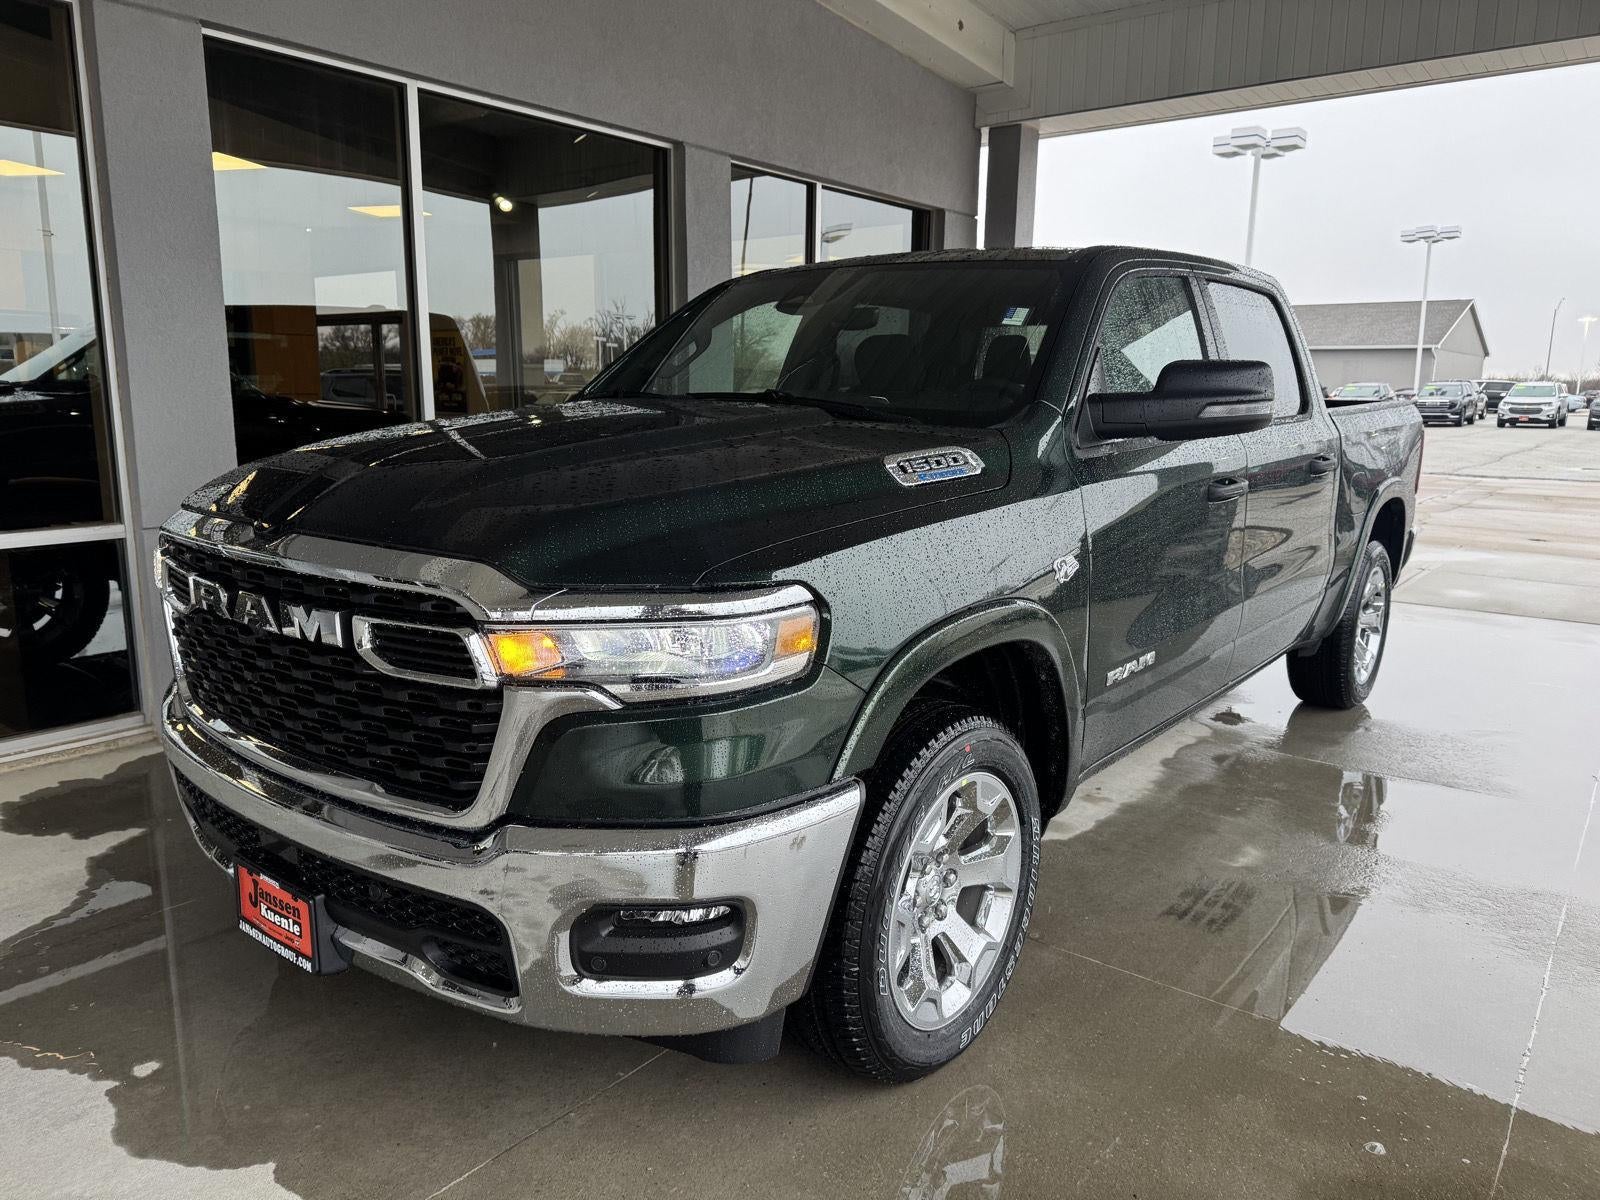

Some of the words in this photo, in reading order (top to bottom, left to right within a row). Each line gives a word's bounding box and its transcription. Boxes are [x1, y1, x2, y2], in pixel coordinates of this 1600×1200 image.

[897, 451, 968, 475] 1500
[189, 574, 343, 648] RAM
[1105, 650, 1156, 687] RAM
[249, 878, 302, 920] Janssen
[260, 903, 301, 937] Kuenle
[959, 816, 1041, 1050] BRIDGESTONE
